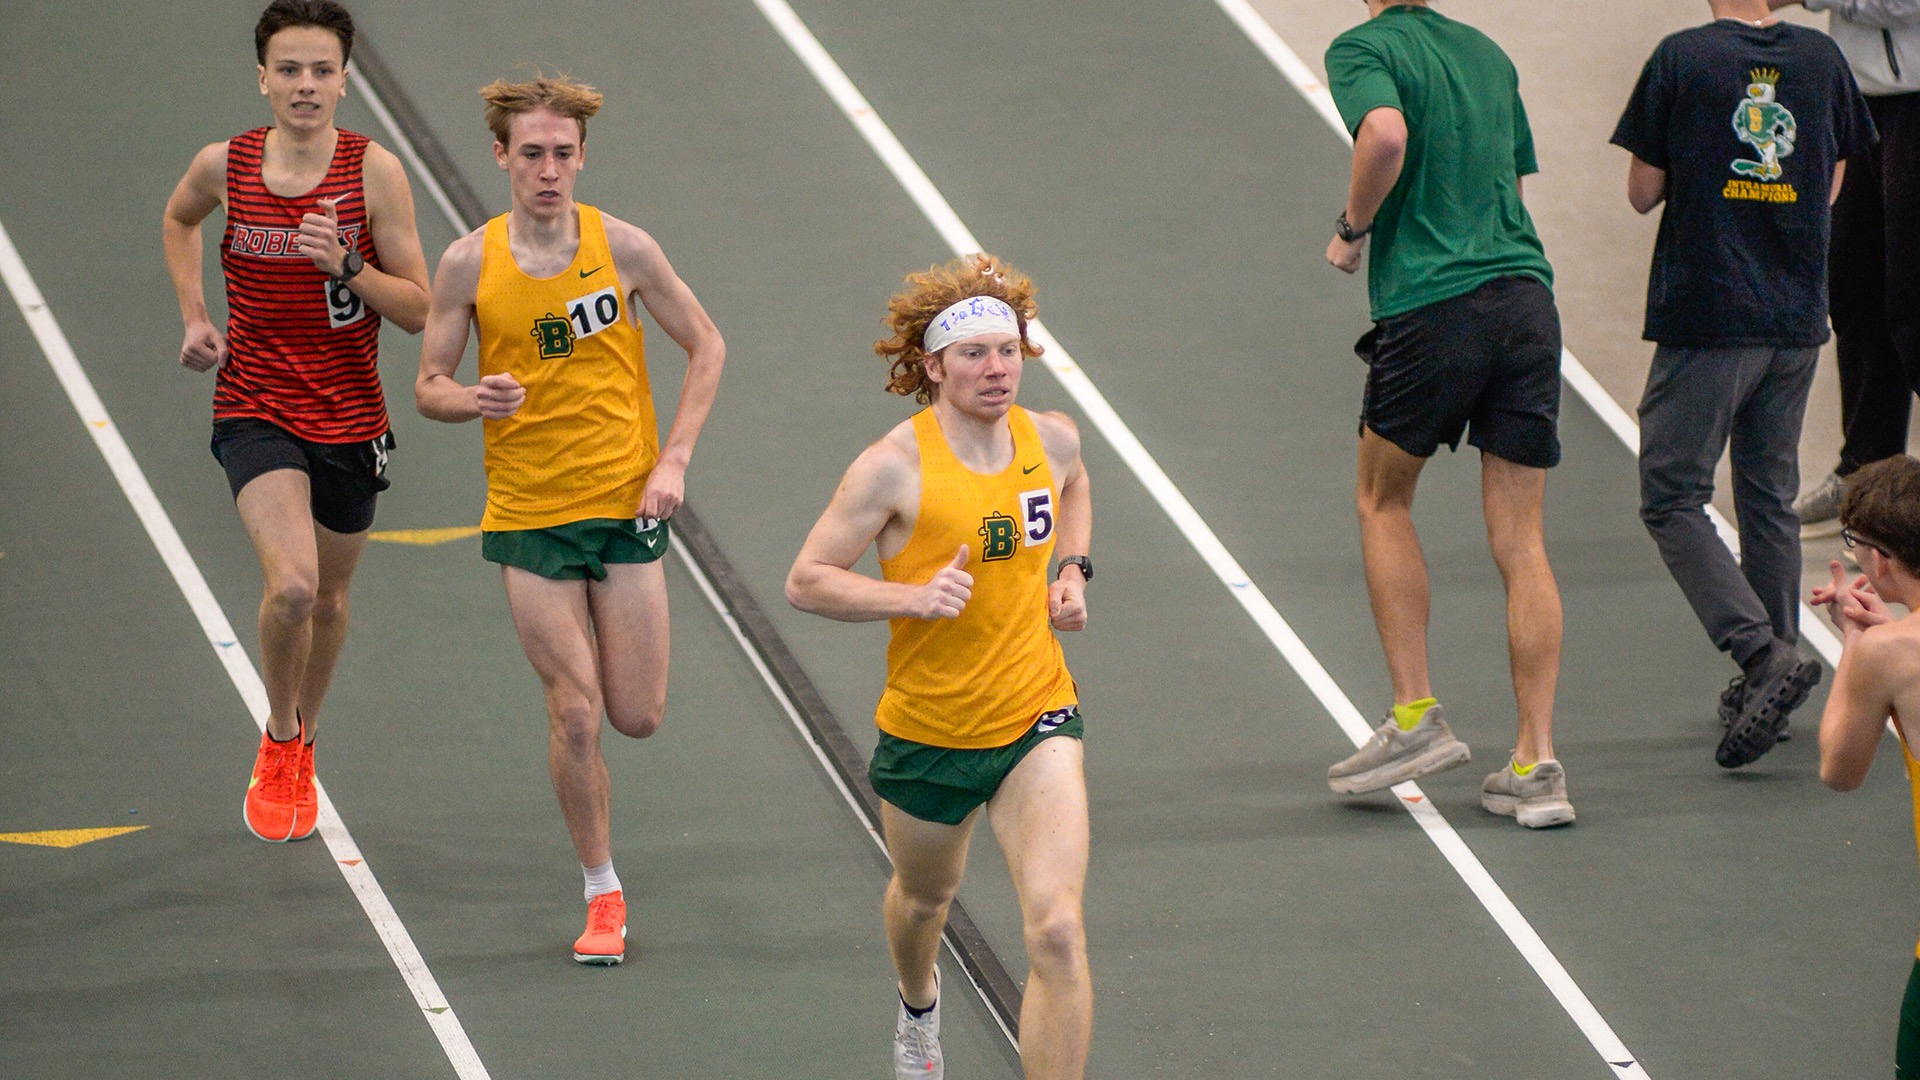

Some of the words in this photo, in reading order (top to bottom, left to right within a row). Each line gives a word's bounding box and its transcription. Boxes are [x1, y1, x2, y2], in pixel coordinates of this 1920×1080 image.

[1748, 107, 1762, 132] B
[1723, 187, 1797, 203] CHAMPIONS
[1727, 179, 1794, 193] INTRAMURAL
[232, 224, 361, 257] ROBES
[330, 282, 361, 321] 9
[569, 293, 618, 335] 10
[533, 315, 574, 360] B
[1027, 494, 1052, 541] 5
[981, 514, 1018, 562] B
